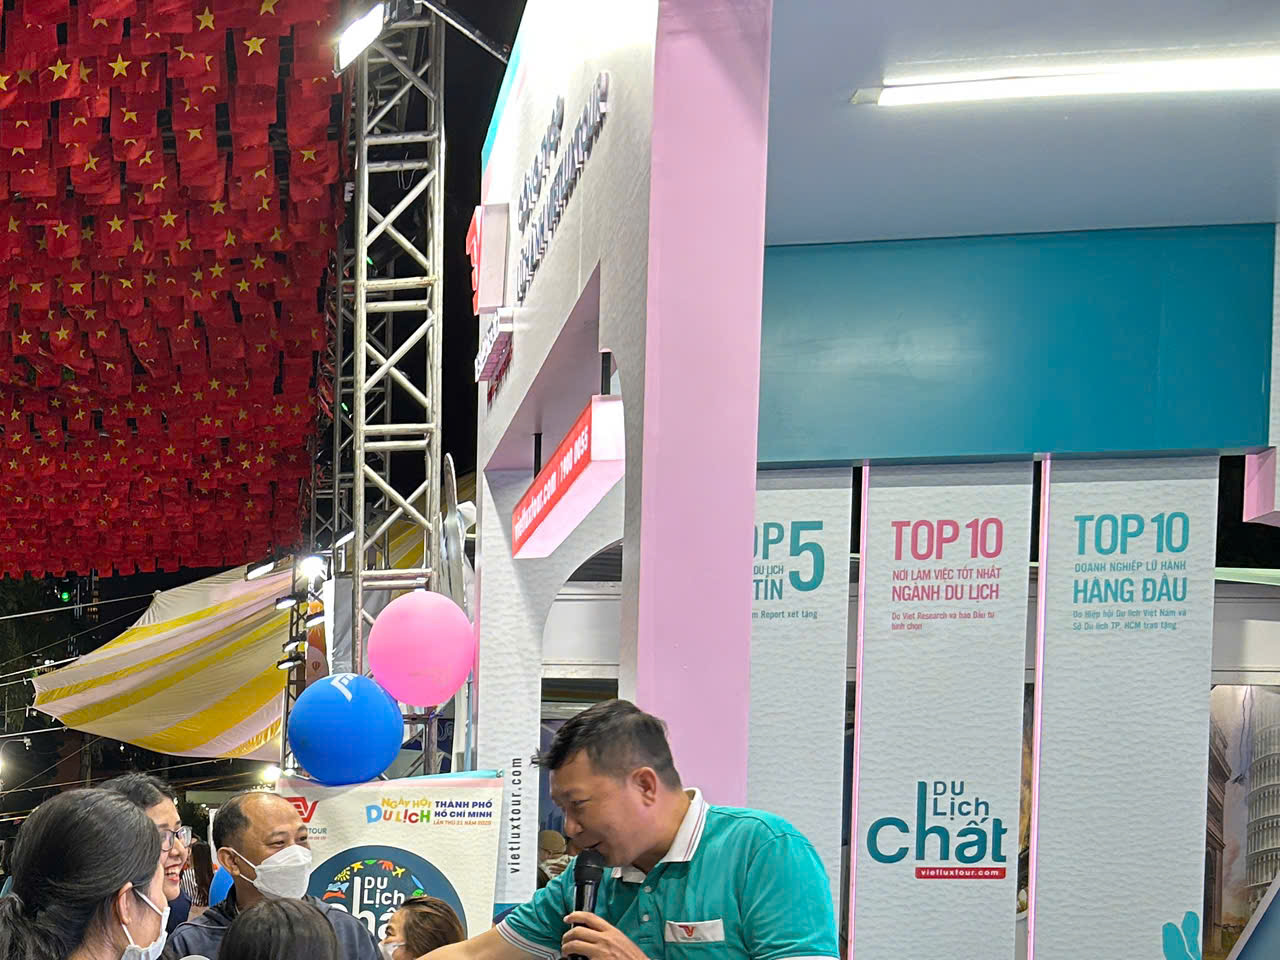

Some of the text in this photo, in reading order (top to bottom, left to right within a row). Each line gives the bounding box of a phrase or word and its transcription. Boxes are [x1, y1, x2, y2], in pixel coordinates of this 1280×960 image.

[891, 517, 1004, 561] TOP 10
[1073, 511, 1190, 556] TOP 10
[788, 520, 826, 592] 5
[1074, 562, 1106, 573] DOANH
[1109, 560, 1143, 573] NGHIỆP
[892, 582, 1000, 604] NGÀNH DU LỊCH
[1073, 573, 1188, 604] HÀNG ĐẦU
[760, 610, 785, 620] Report
[933, 780, 965, 796] DU
[434, 798, 493, 809] THÀNH PHỐ
[434, 808, 493, 818] HỒ CHÍ MINH
[932, 797, 990, 821] Lịch
[508, 757, 522, 874] vietluxtour.com
[363, 876, 389, 890] DU
[363, 889, 406, 909] Lịch
